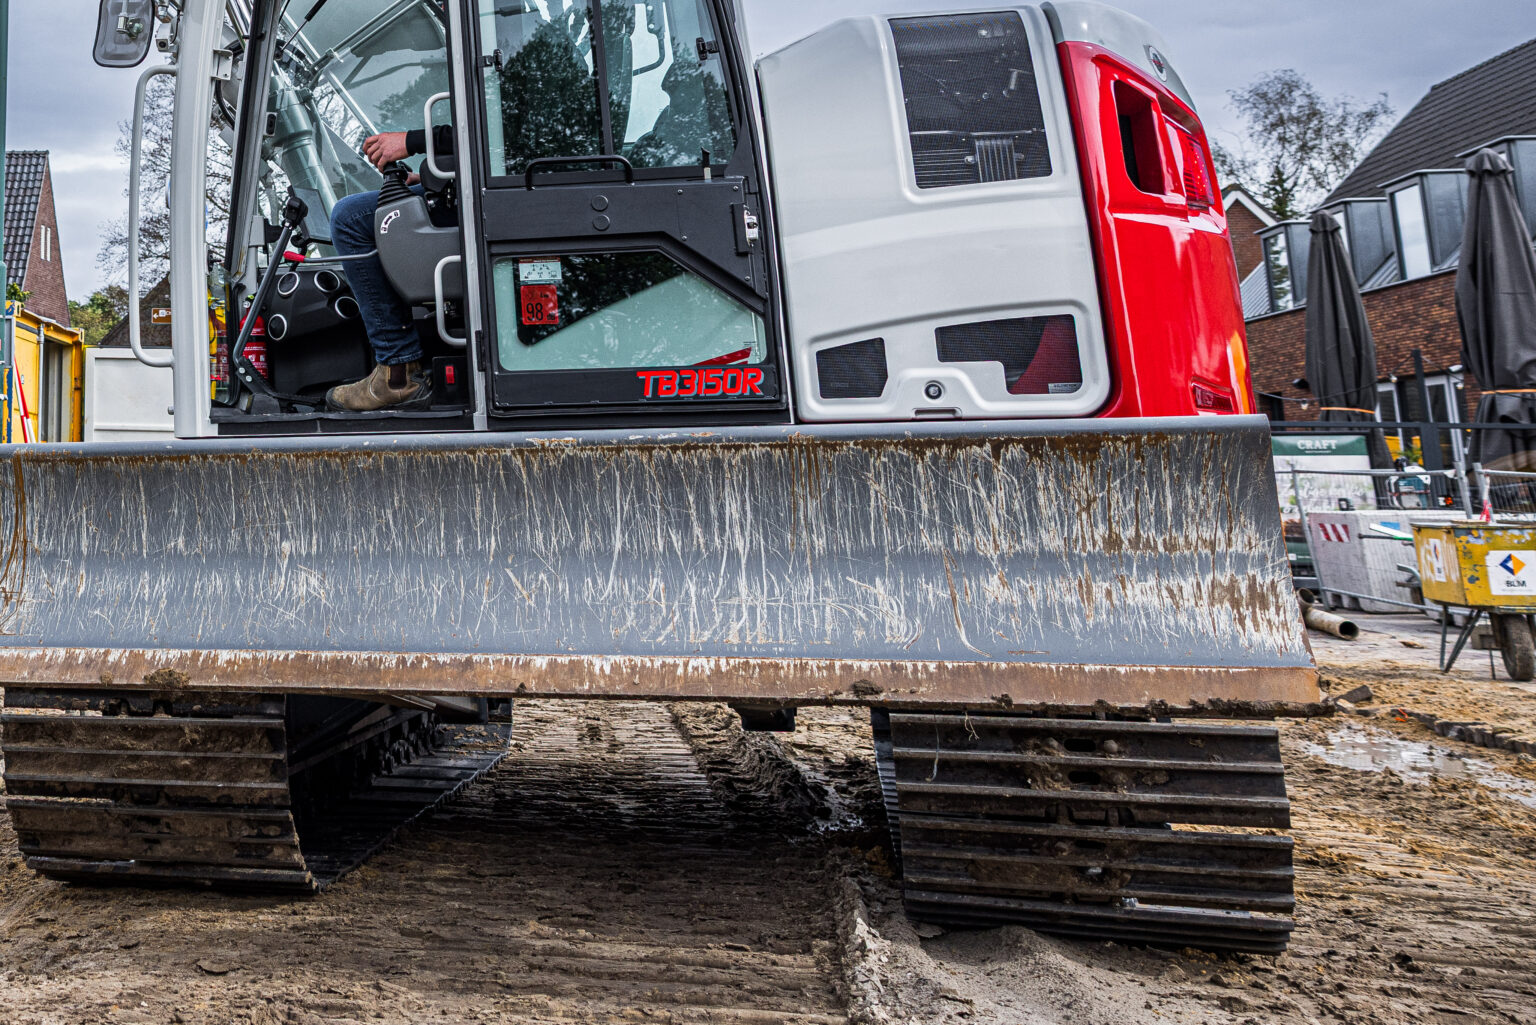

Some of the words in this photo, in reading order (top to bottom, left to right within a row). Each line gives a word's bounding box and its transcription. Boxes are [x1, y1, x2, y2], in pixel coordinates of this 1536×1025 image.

[526, 302, 544, 322] 98
[636, 368, 764, 398] TB3150R
[1297, 439, 1338, 450] CRAFT
